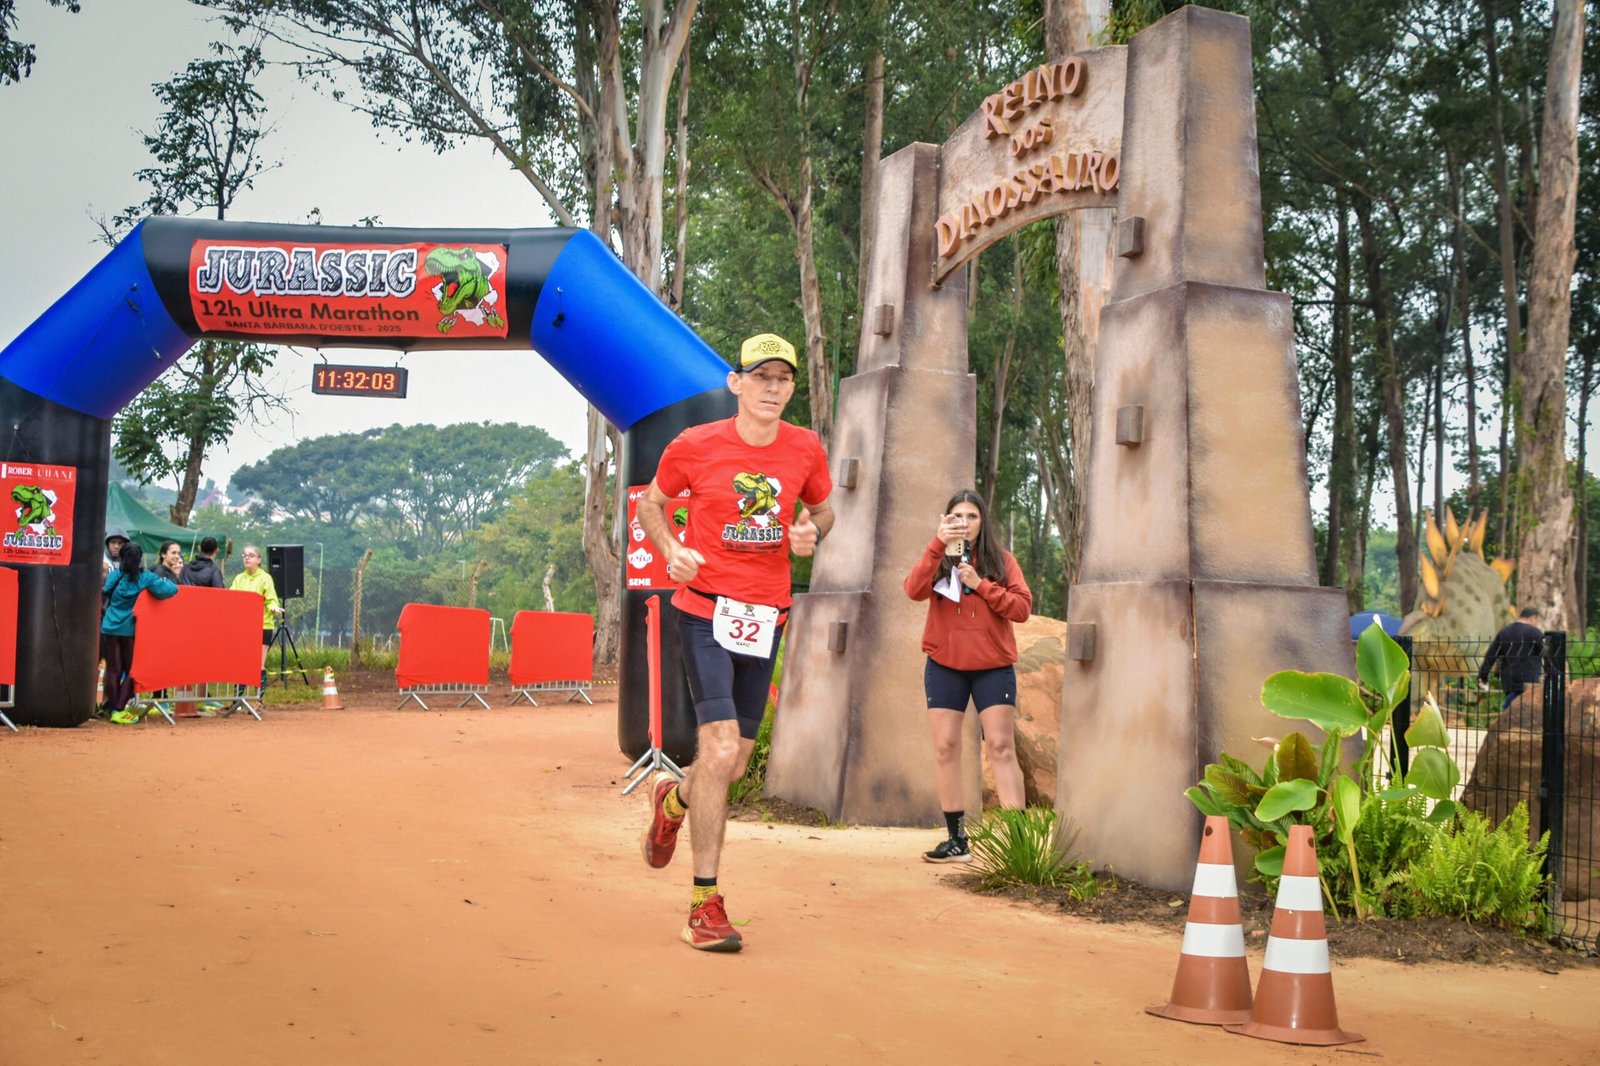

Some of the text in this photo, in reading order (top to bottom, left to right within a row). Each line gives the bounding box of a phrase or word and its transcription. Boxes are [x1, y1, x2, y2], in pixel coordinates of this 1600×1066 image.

[981, 56, 1087, 140] REINO
[1011, 118, 1053, 158] DOS
[935, 150, 1120, 257] DINOSSAURO
[198, 247, 417, 297] JURASSIC
[200, 300, 419, 321] 12h Ultra Marathon
[225, 320, 261, 330] SANTA
[319, 323, 366, 332] D'OESTE
[378, 324, 402, 333] 2025
[318, 370, 395, 390] 11:32:03
[8, 466, 33, 475] ROBER
[3, 532, 63, 549] JURASSIC
[722, 524, 783, 542] JURASSIC
[628, 577, 652, 586] SEME
[729, 619, 760, 642] 32
